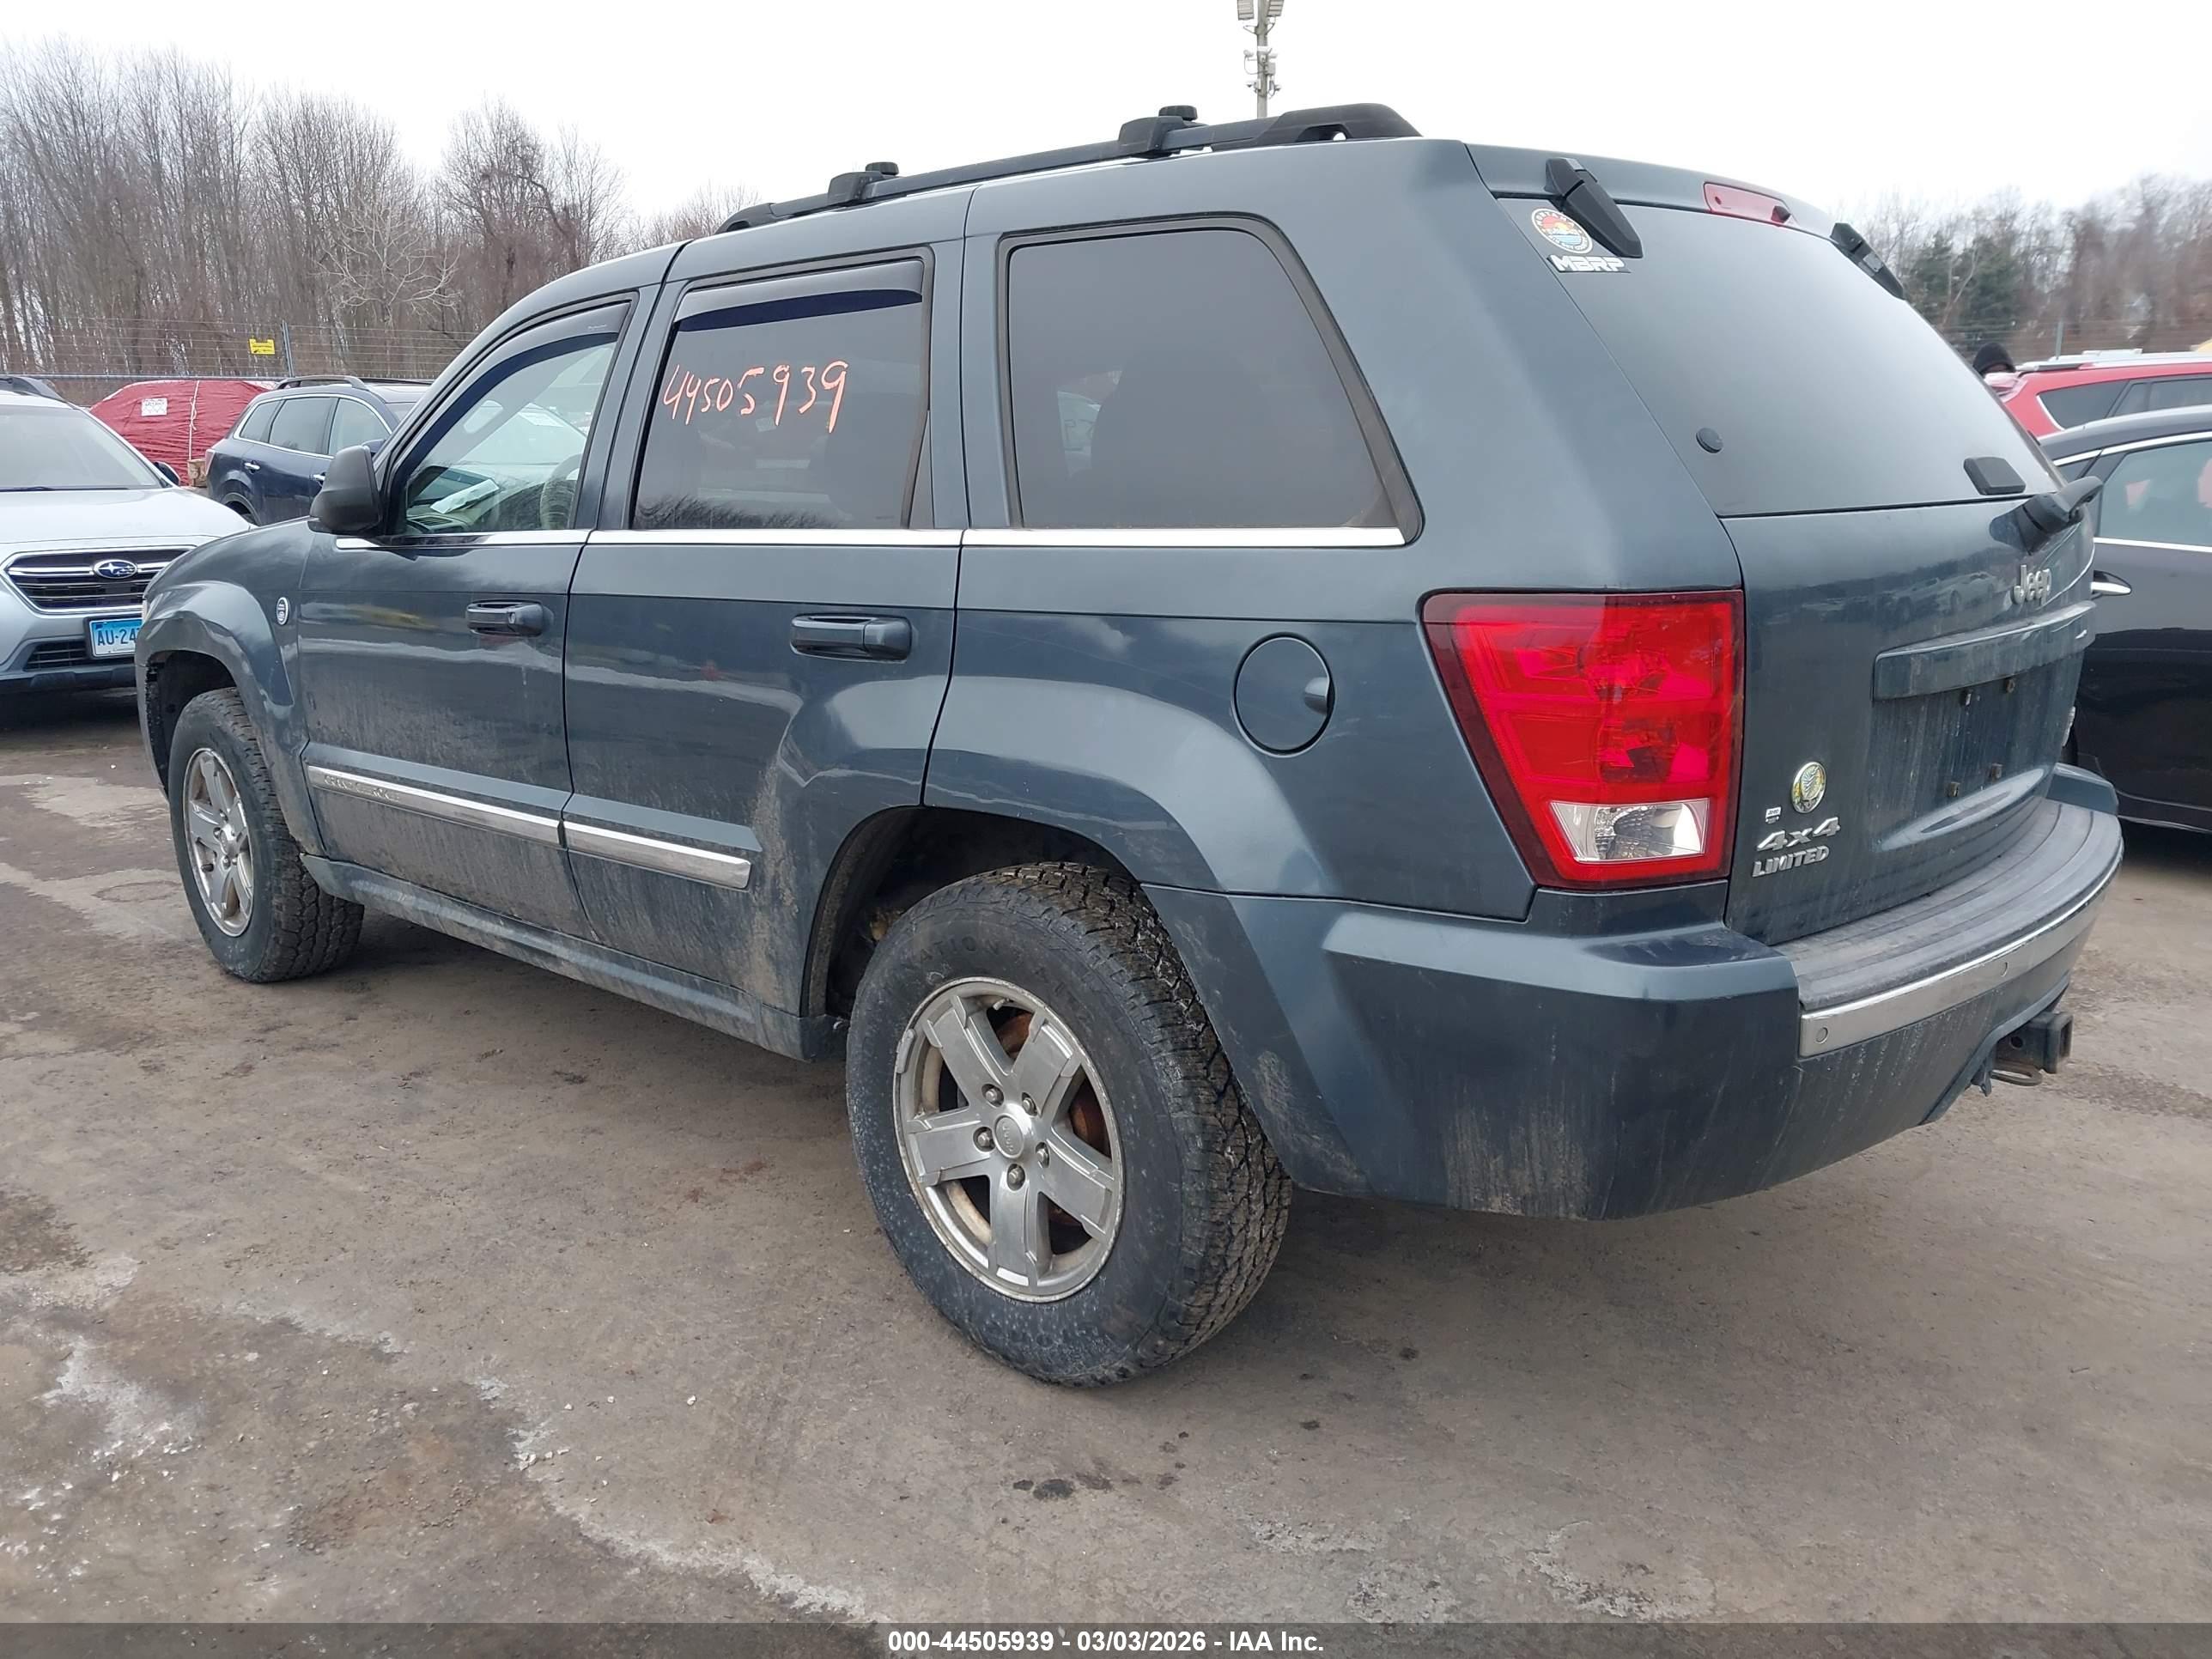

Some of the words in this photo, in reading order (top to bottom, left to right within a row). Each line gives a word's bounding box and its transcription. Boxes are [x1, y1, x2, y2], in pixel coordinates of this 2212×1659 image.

[1549, 254, 1625, 272] MBRP
[663, 361, 848, 433] 44505939
[2012, 564, 2051, 606] Jeep
[1757, 817, 1841, 852] 4x4
[1752, 845, 1830, 877] LIMITED
